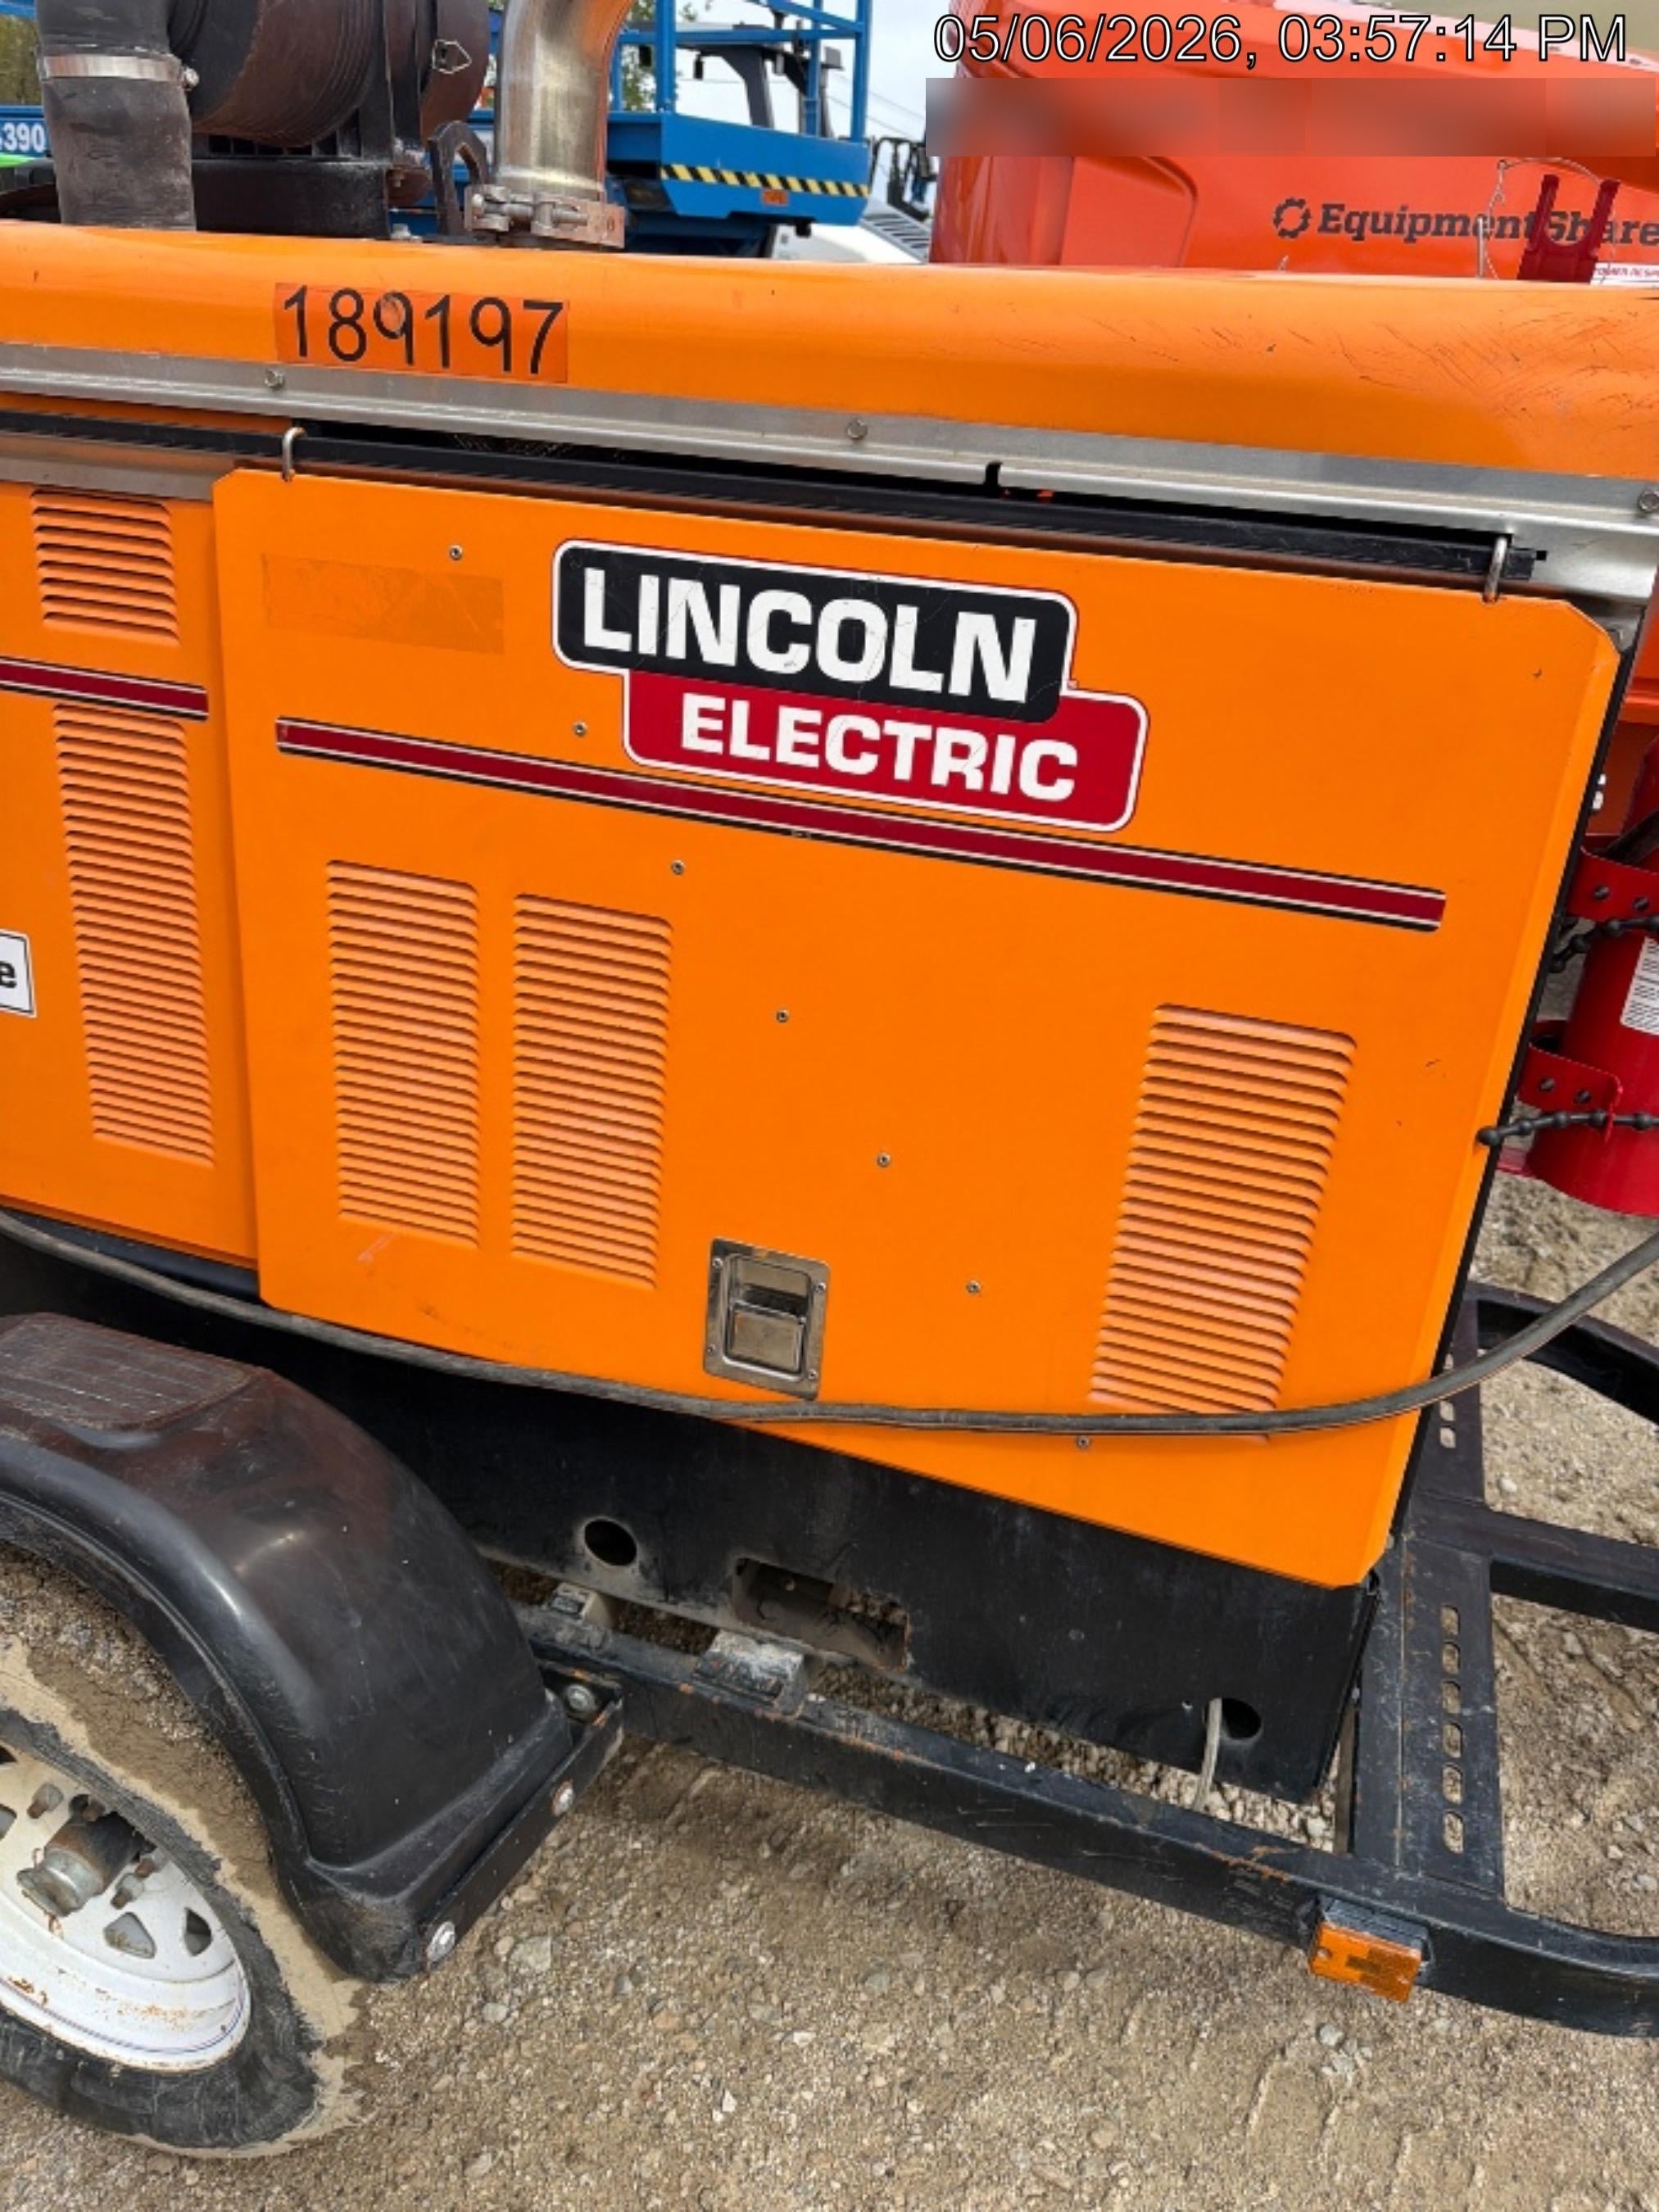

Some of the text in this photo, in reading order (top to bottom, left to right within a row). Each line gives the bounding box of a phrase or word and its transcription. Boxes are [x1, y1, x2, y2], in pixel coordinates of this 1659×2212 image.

[283, 285, 564, 375] 189197
[583, 566, 1036, 704] LINCOLN
[682, 692, 1078, 802] ELECTRIC
